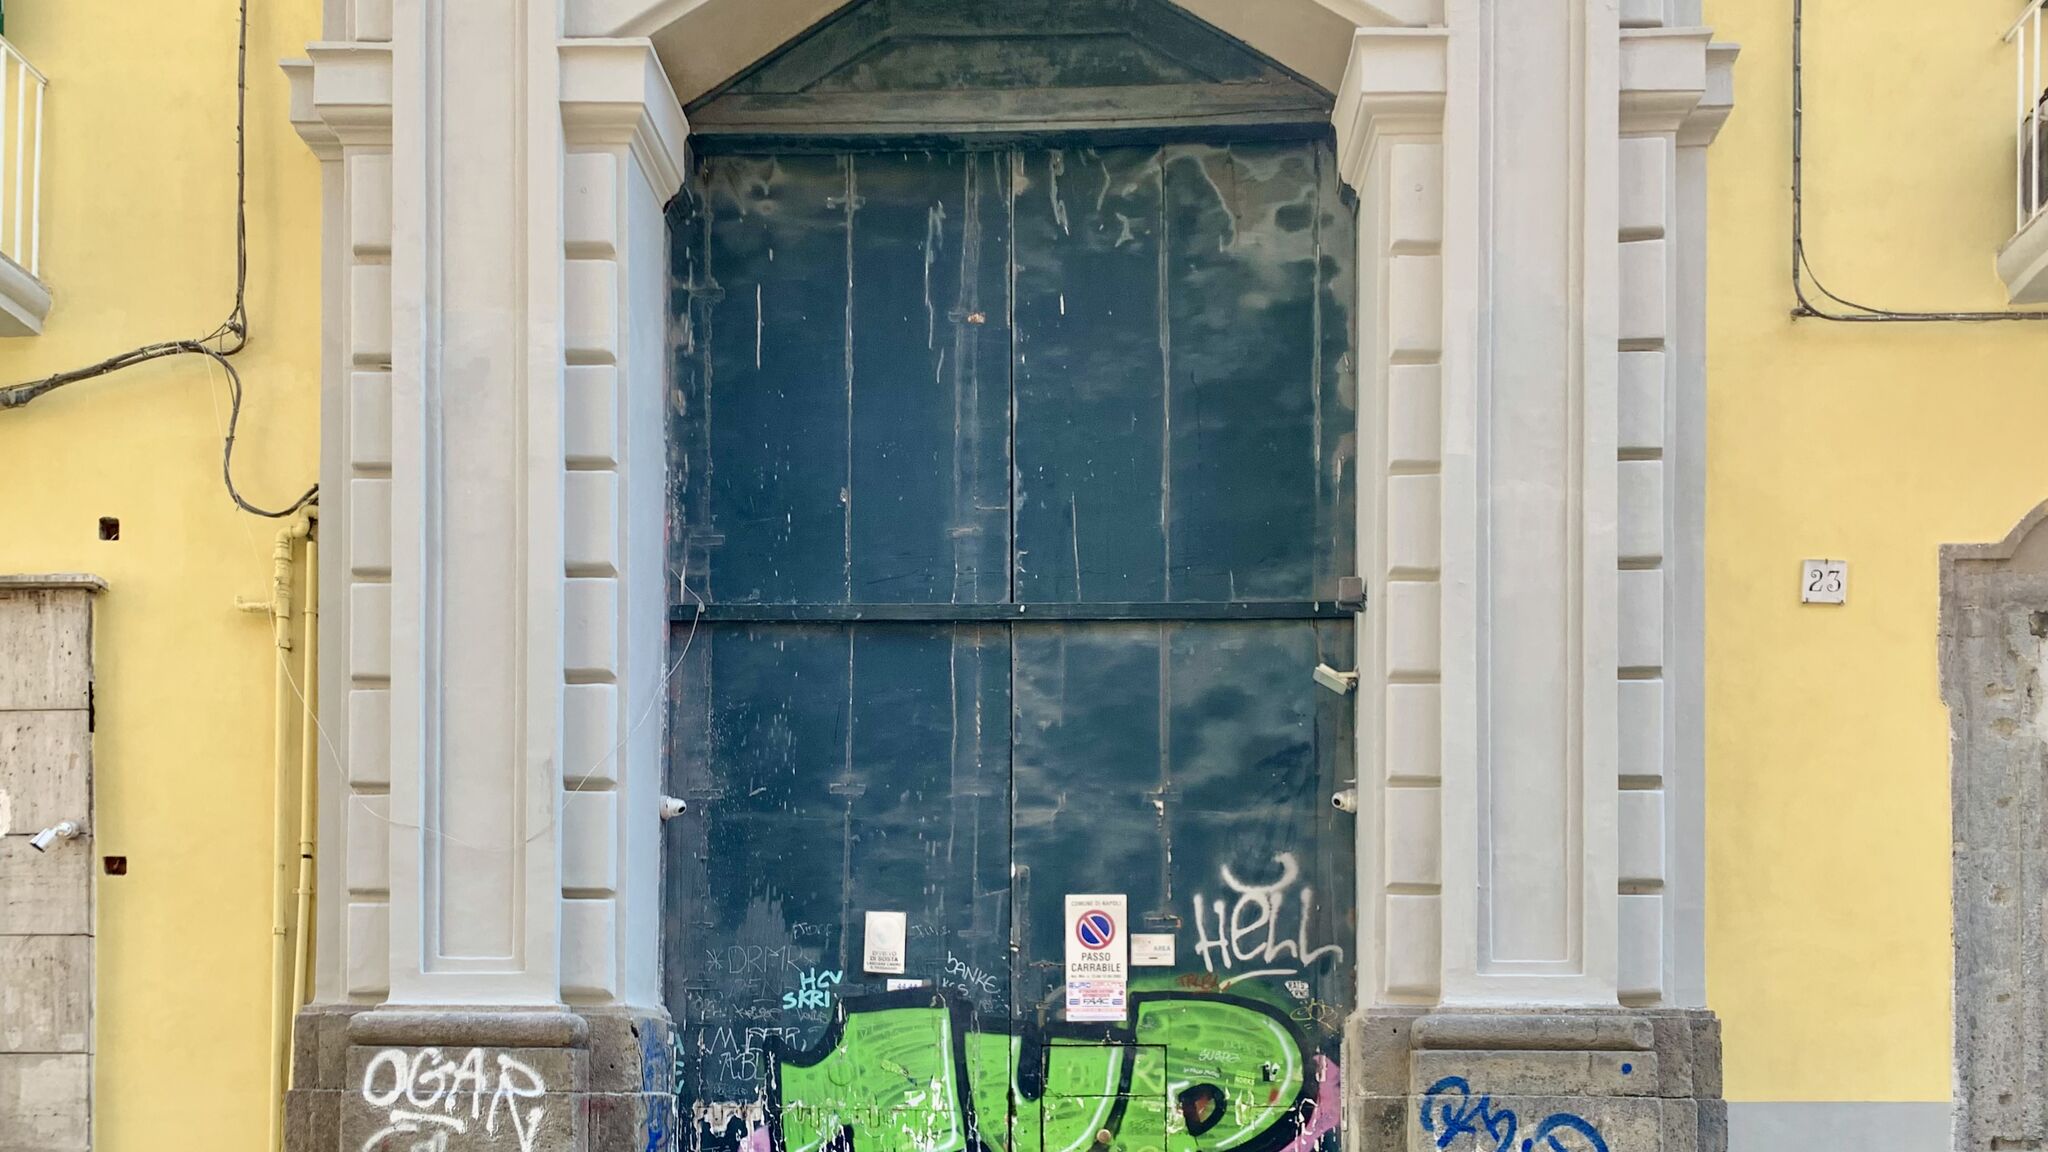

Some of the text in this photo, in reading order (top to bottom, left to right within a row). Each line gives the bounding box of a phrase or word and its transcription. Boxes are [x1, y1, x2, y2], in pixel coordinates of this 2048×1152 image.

[1809, 569, 1841, 592] 23
[1081, 952, 1111, 961] PASSO
[1071, 963, 1121, 972] CARRABILE
